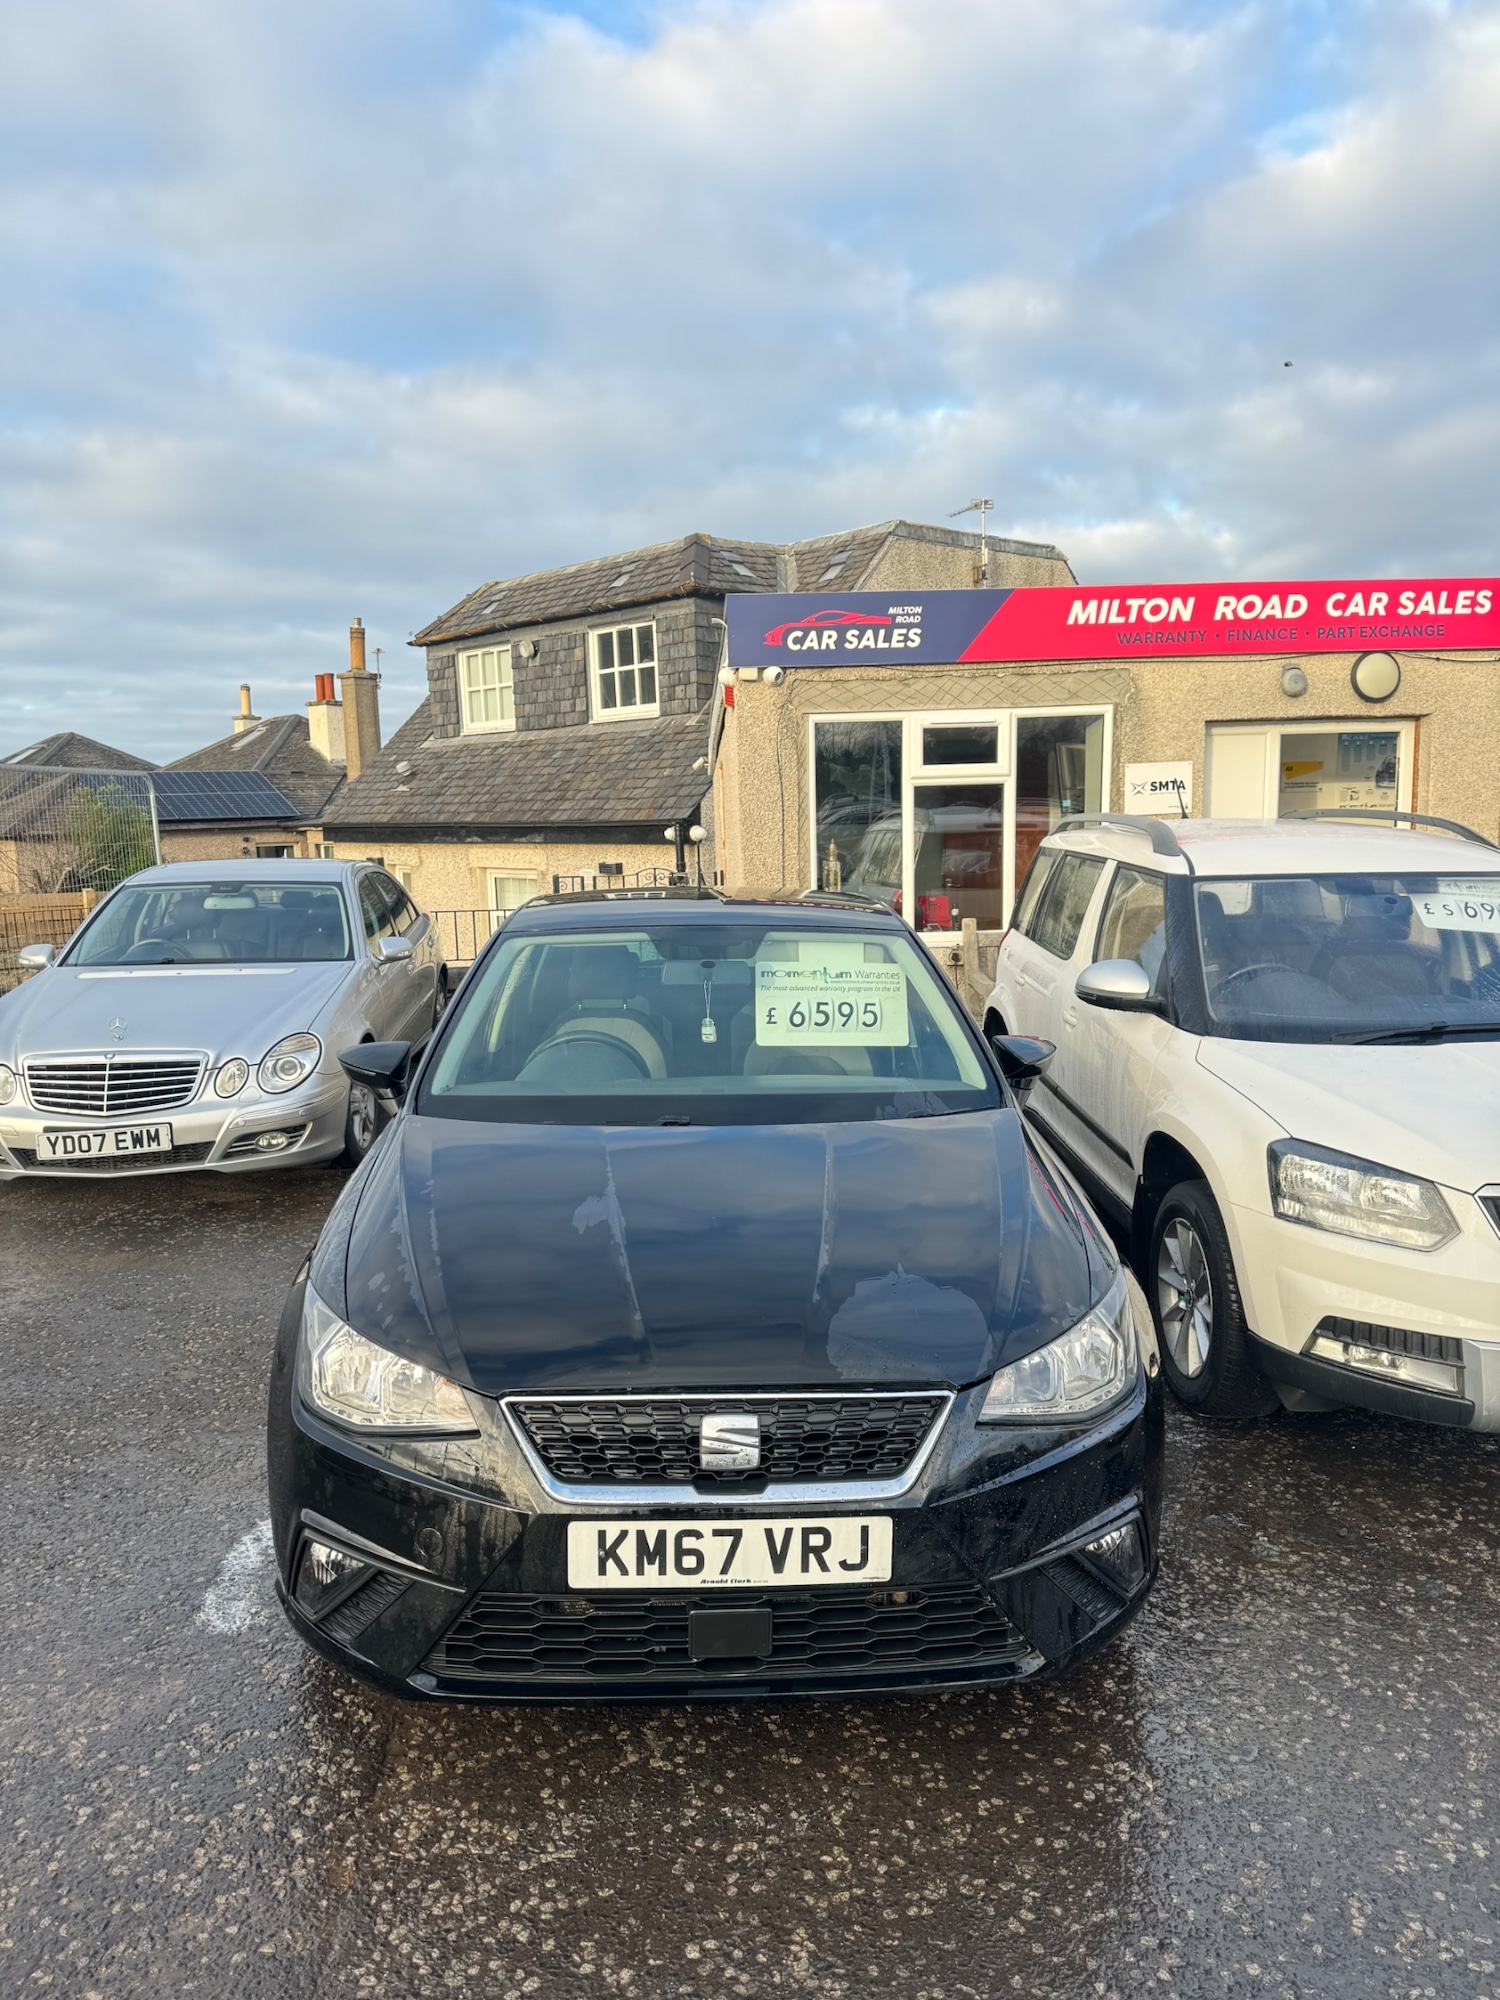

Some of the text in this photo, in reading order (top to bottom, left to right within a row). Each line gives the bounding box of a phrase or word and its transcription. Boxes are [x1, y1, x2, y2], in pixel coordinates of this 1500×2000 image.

[888, 606, 922, 615] MILTON
[1066, 589, 1493, 625] MILTON ROAD CAR SALES
[895, 615, 921, 624] ROAD
[787, 627, 922, 651] CAR SALES
[1117, 624, 1445, 645] WARRANTY FINANCE PART EXCHANGE
[1150, 780, 1186, 792] SMTA
[760, 966, 901, 984] momentum Warranties
[788, 1001, 879, 1028] 6595
[46, 1128, 161, 1156] YD07 EWM
[597, 1524, 870, 1577] KM67 VRJ
